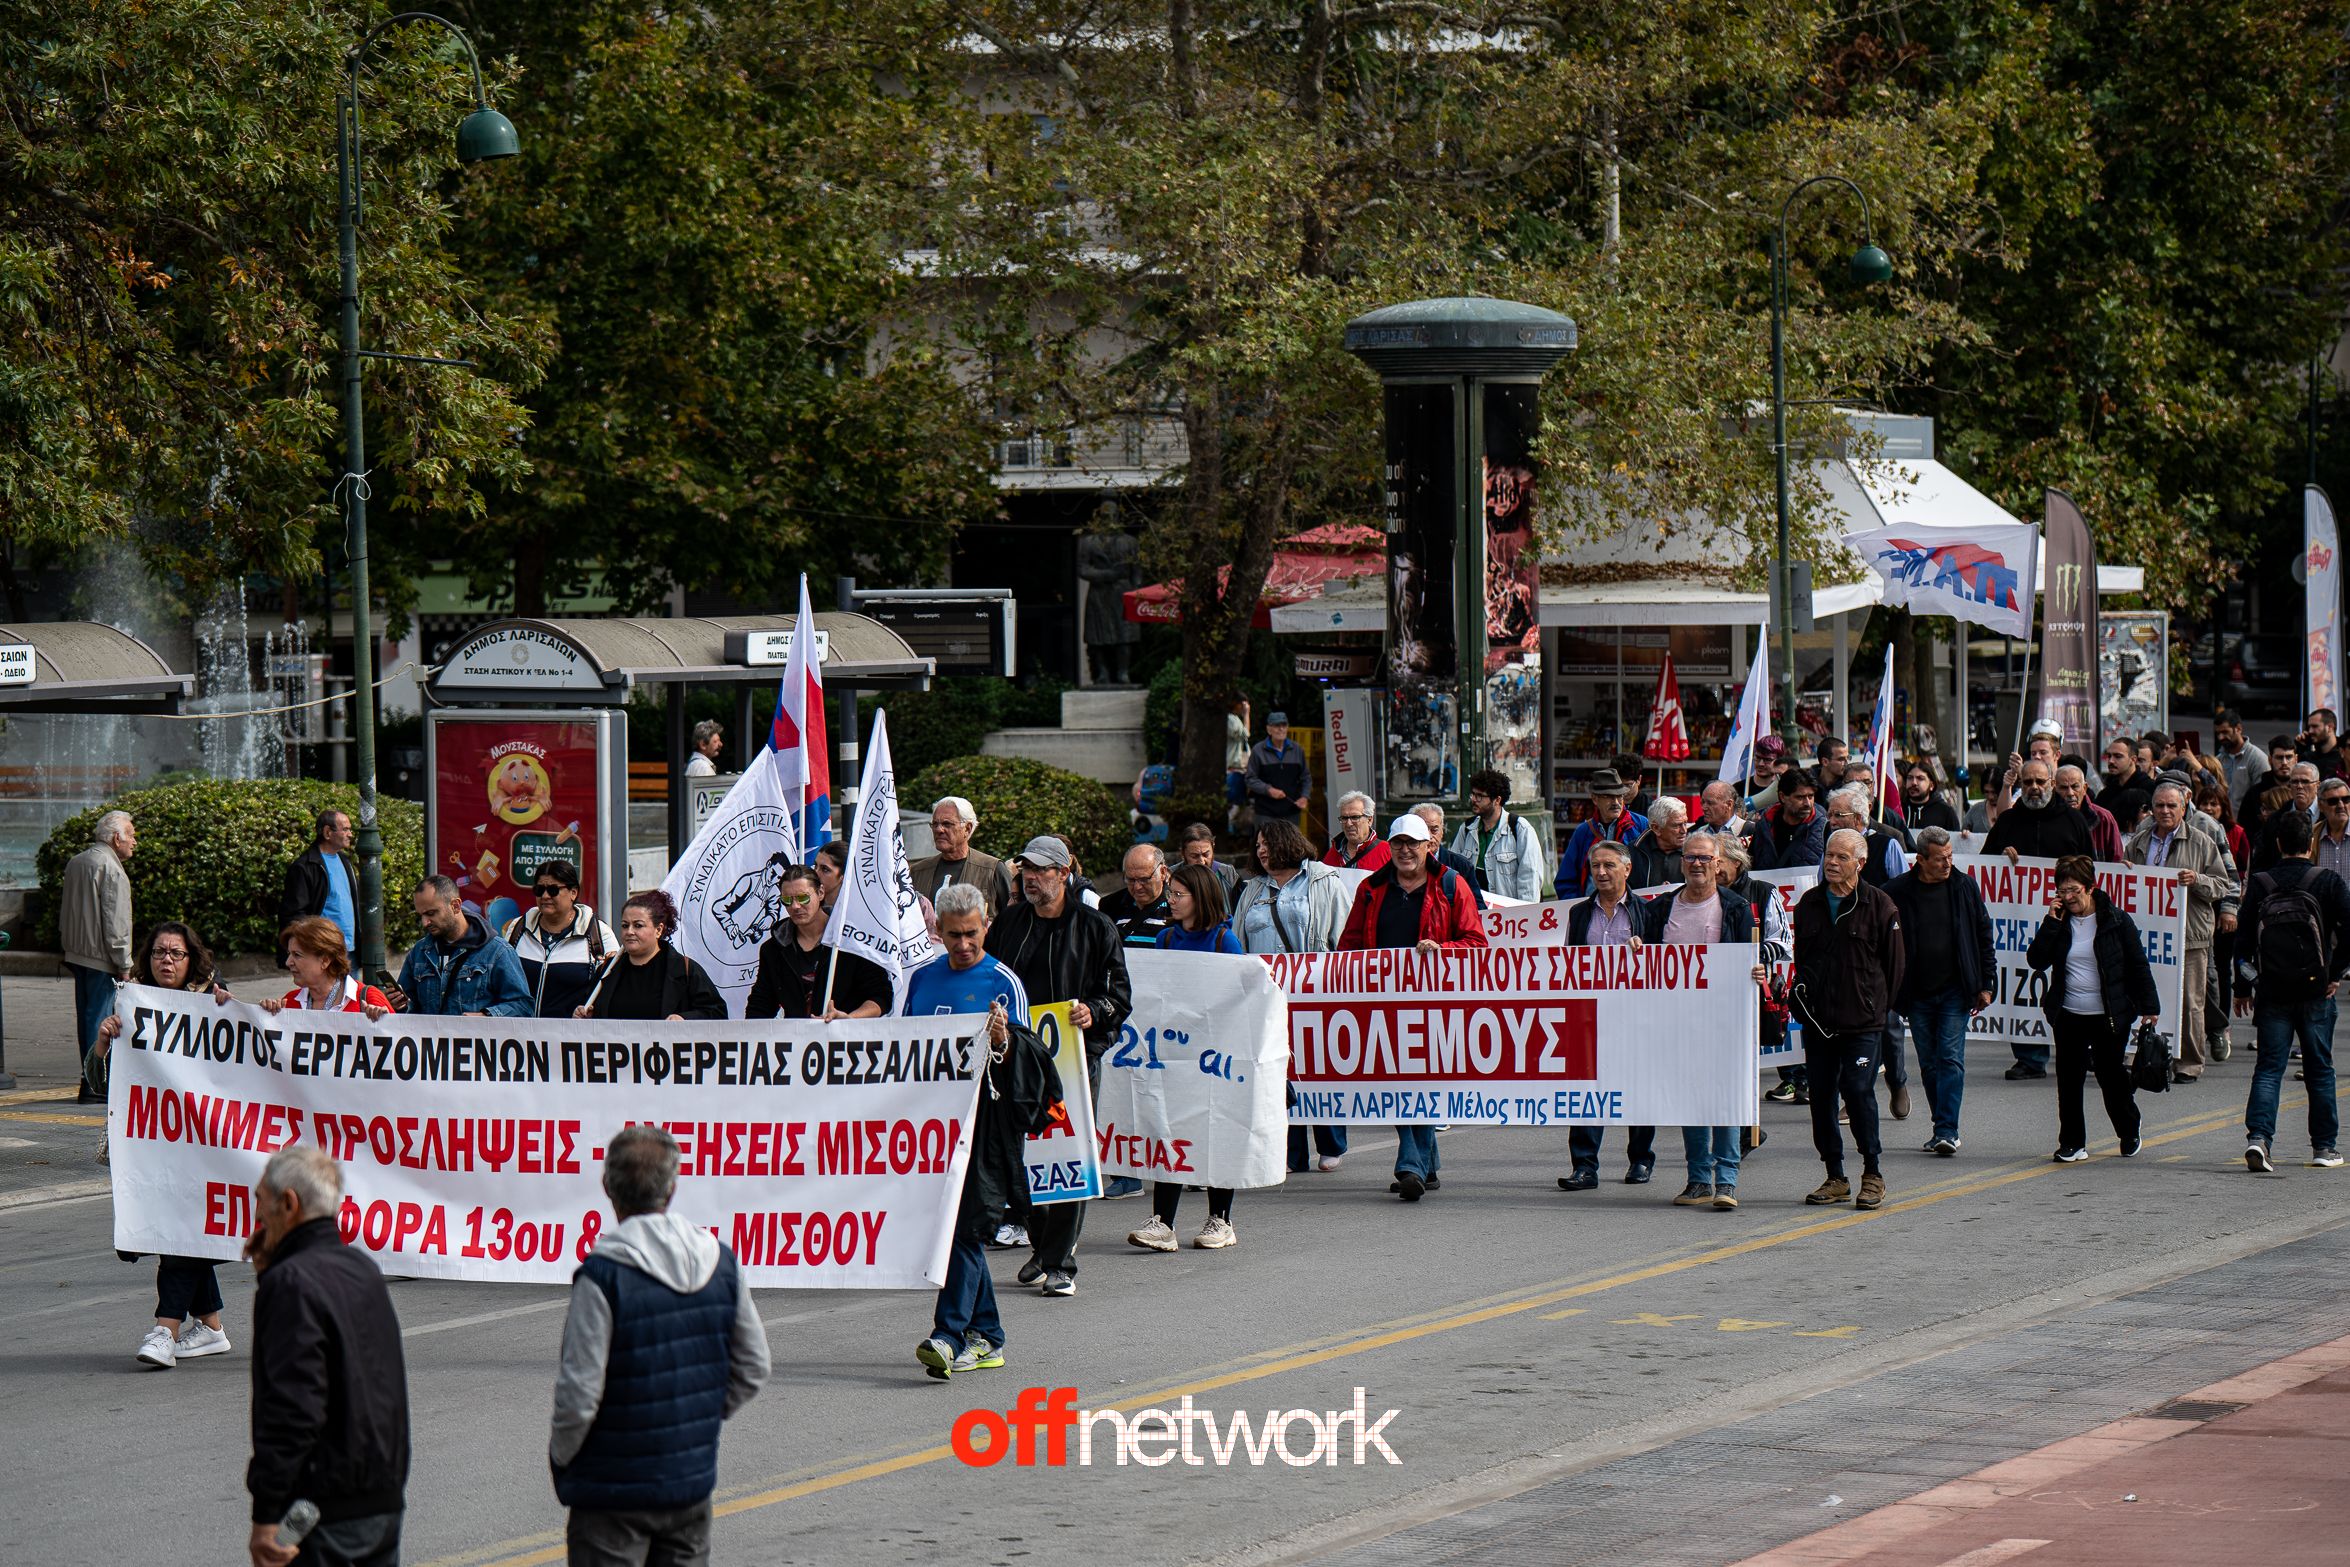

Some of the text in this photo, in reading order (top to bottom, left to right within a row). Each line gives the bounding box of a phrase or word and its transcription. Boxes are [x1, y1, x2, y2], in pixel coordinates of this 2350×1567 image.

[463, 629, 578, 663] ΔΗΜΟΣ ΛΑΡΙΣΑΙΩΝ
[767, 635, 789, 645] ΔΗΜΟΣ
[767, 651, 788, 659] ΠΛΑΤΕΙΑ
[1702, 645, 1729, 658] ploom
[4, 668, 26, 678] ΩΔΕΙΟ
[491, 668, 525, 676] ΑΣΤΙΚΟΥ
[526, 668, 547, 676] ΚΕΛ
[1296, 657, 1351, 672] MURAI
[491, 741, 547, 759] ΜΟΥΣΤΑΚΑΣ
[1330, 709, 1352, 773] Red Bull
[521, 845, 574, 855] ΜΕ ΣΥΛΛΟΓΗ
[861, 798, 884, 887] ΣΥΝΔΙΚΑΤΟ
[515, 856, 533, 864] ΑΠΟ
[689, 827, 738, 903] ΣΥΝΔΙΚΑΤΟ
[2145, 876, 2178, 918] ΤΙΣ
[1538, 908, 1559, 930] &
[1322, 946, 1539, 994] ΙΜΠΕΡΙΑΛΙΣΤΙΚΟΥΣ
[1548, 944, 1709, 991] ΣΧΕΔΙΑΣΜΟΥΣ
[1292, 1007, 1567, 1076] ΠΟΛΕΜΟΥΣ
[2010, 1018, 2047, 1038] ΙΚΑ
[131, 1007, 976, 1086] ΣΥΛΛΟΓΟΣ ΕΡΓΑΖΟΜΕΝΩΝ ΠΕΡΙΦΕΡΕΙΑΣ ΘΕΣΣΑΛΙΑΣ
[1351, 1091, 1441, 1119] ΛΑΡΙΣΑΣ
[1447, 1091, 1509, 1124] Μέλος
[1514, 1098, 1548, 1125] της
[1554, 1091, 1623, 1119] ΕΕΔΥΕ
[126, 1085, 304, 1153] ΜΟΝΙΜΕΣ
[313, 1112, 581, 1174] ΠΡΟΣΛΗΨΕΙΣ
[623, 1121, 806, 1176] ΞΗΣΕΙΣ
[1096, 1122, 1195, 1173] ΥΓΕΙΑΣ
[204, 1181, 448, 1256] ΕΠΦΟΡΑ
[461, 1206, 565, 1263] 13ου
[732, 1210, 887, 1267] ΜΙΣΘΟΥ
